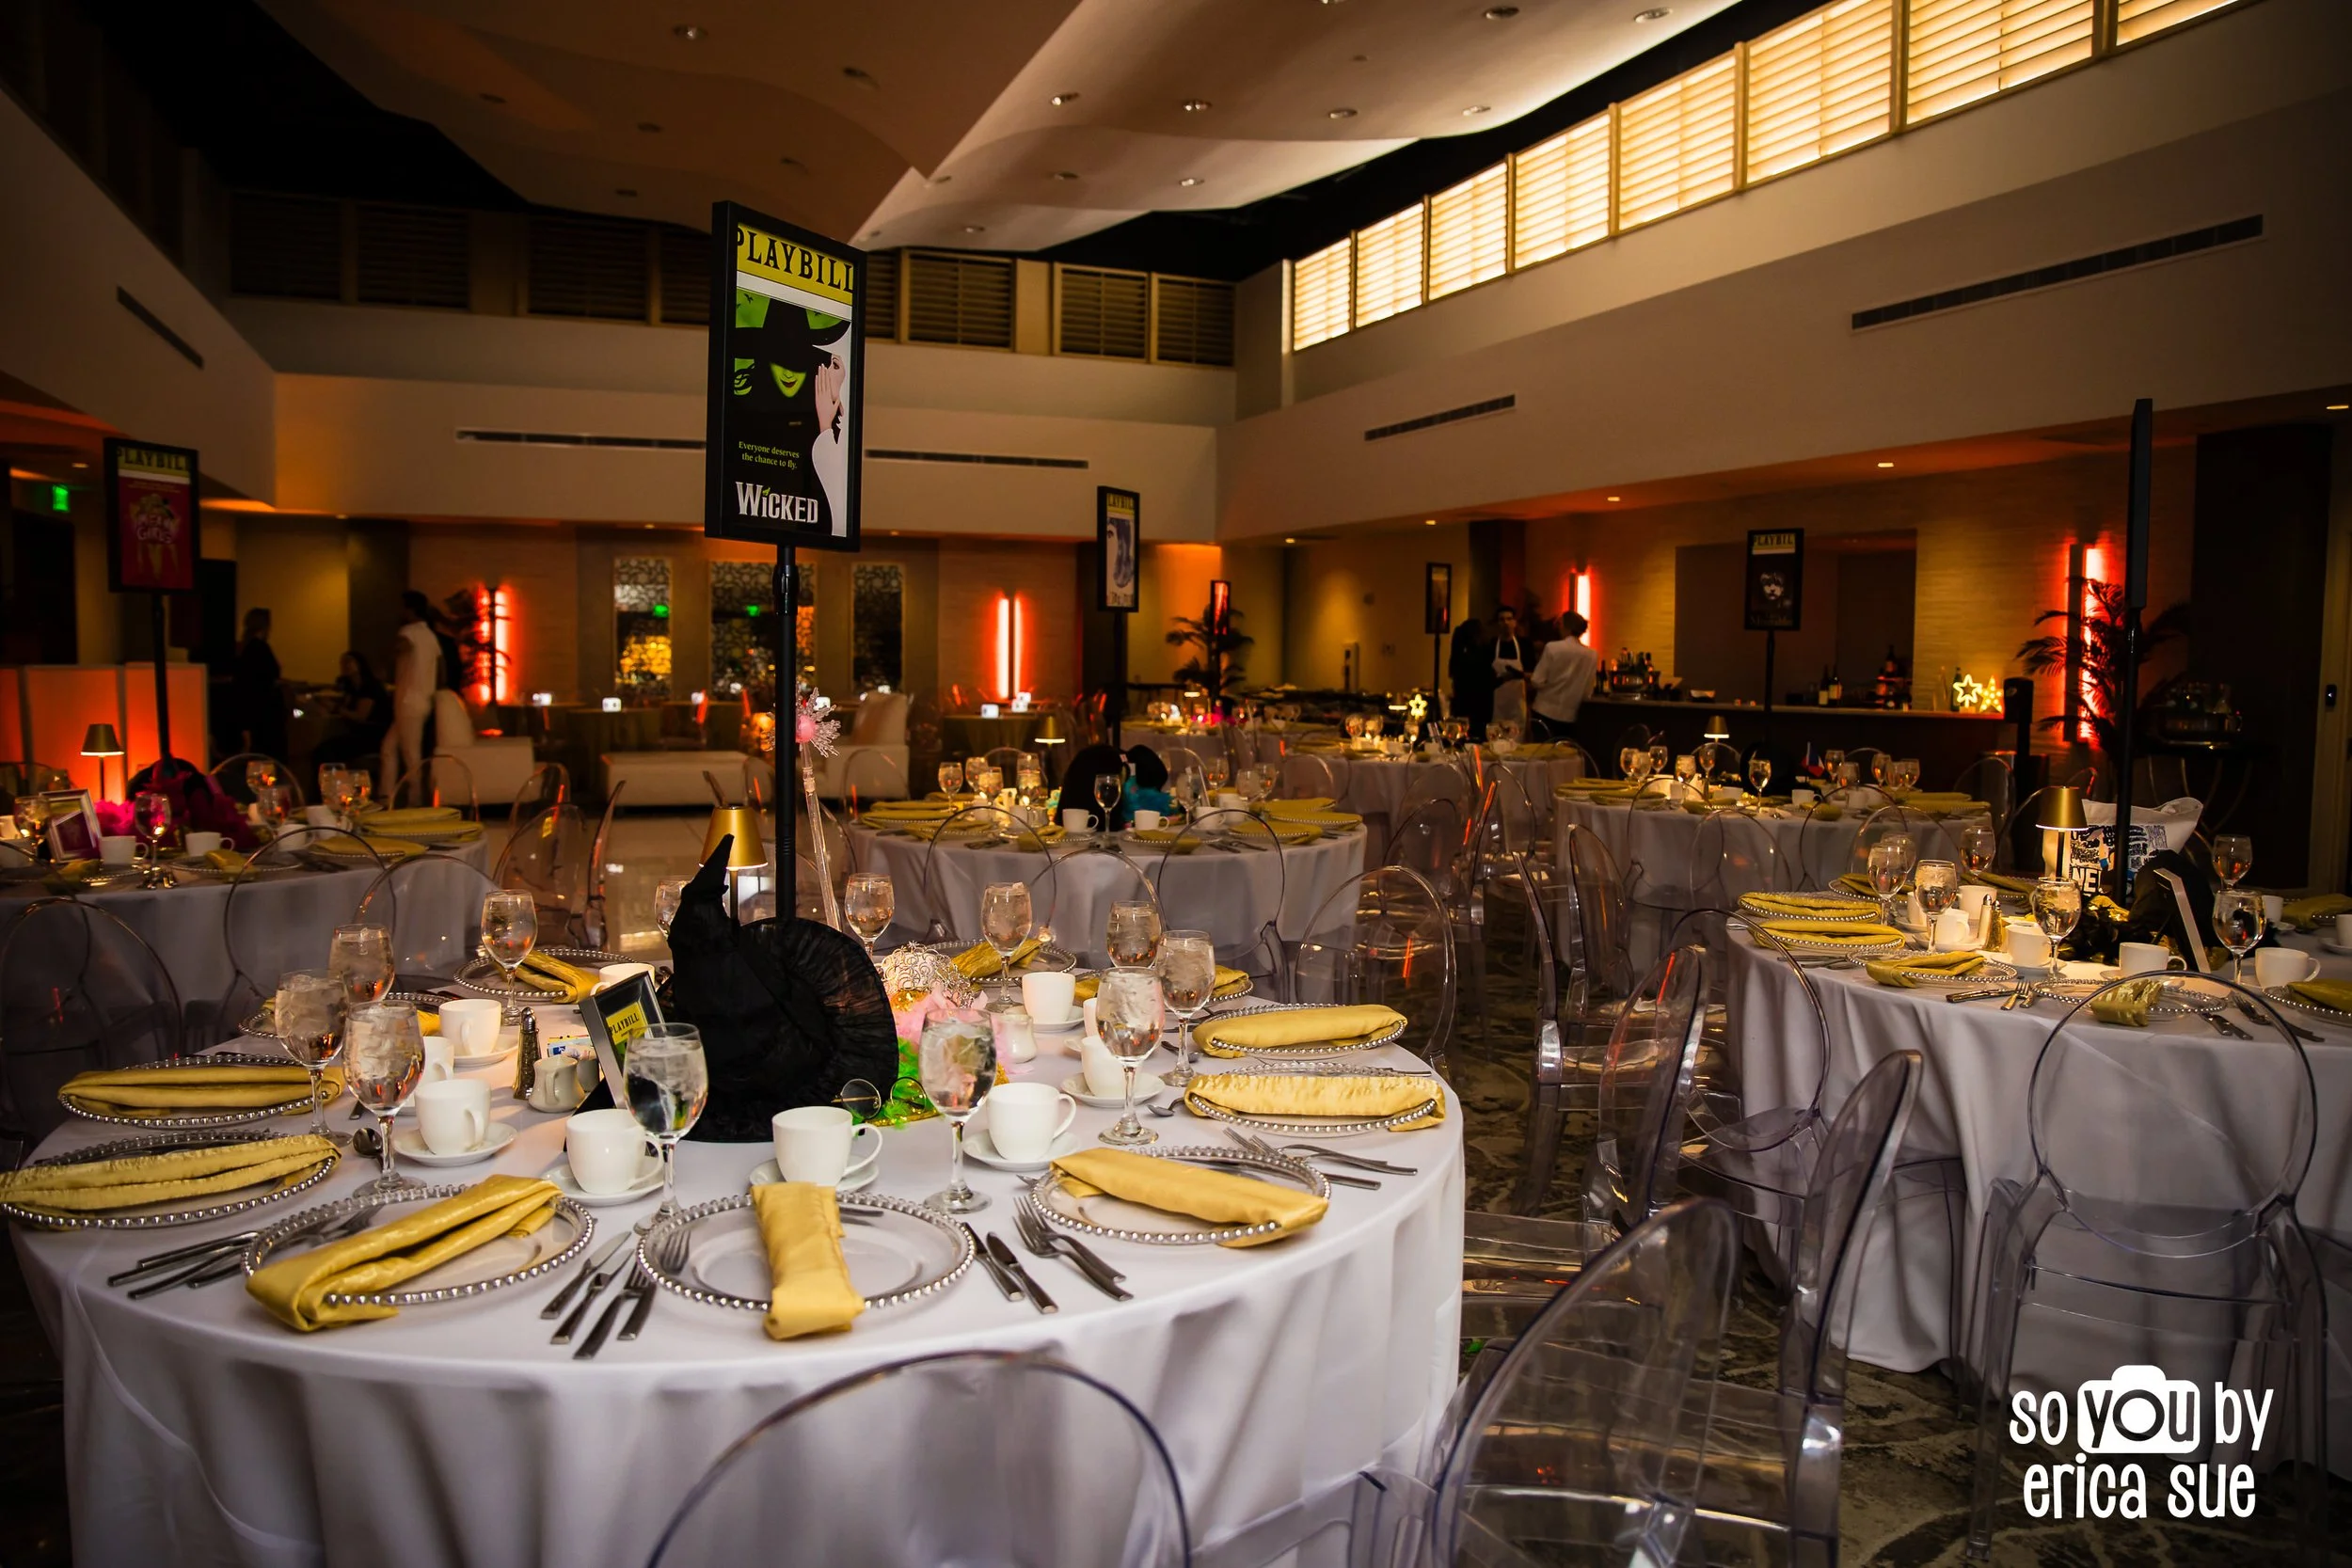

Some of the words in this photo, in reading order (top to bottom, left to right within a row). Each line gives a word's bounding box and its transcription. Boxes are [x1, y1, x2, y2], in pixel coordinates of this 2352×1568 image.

[739, 441, 770, 452] Everyone
[771, 447, 800, 458] deserves
[118, 447, 191, 471] LAYBIL
[742, 452, 753, 461] the
[755, 454, 778, 465] chance
[787, 459, 798, 469] fly.
